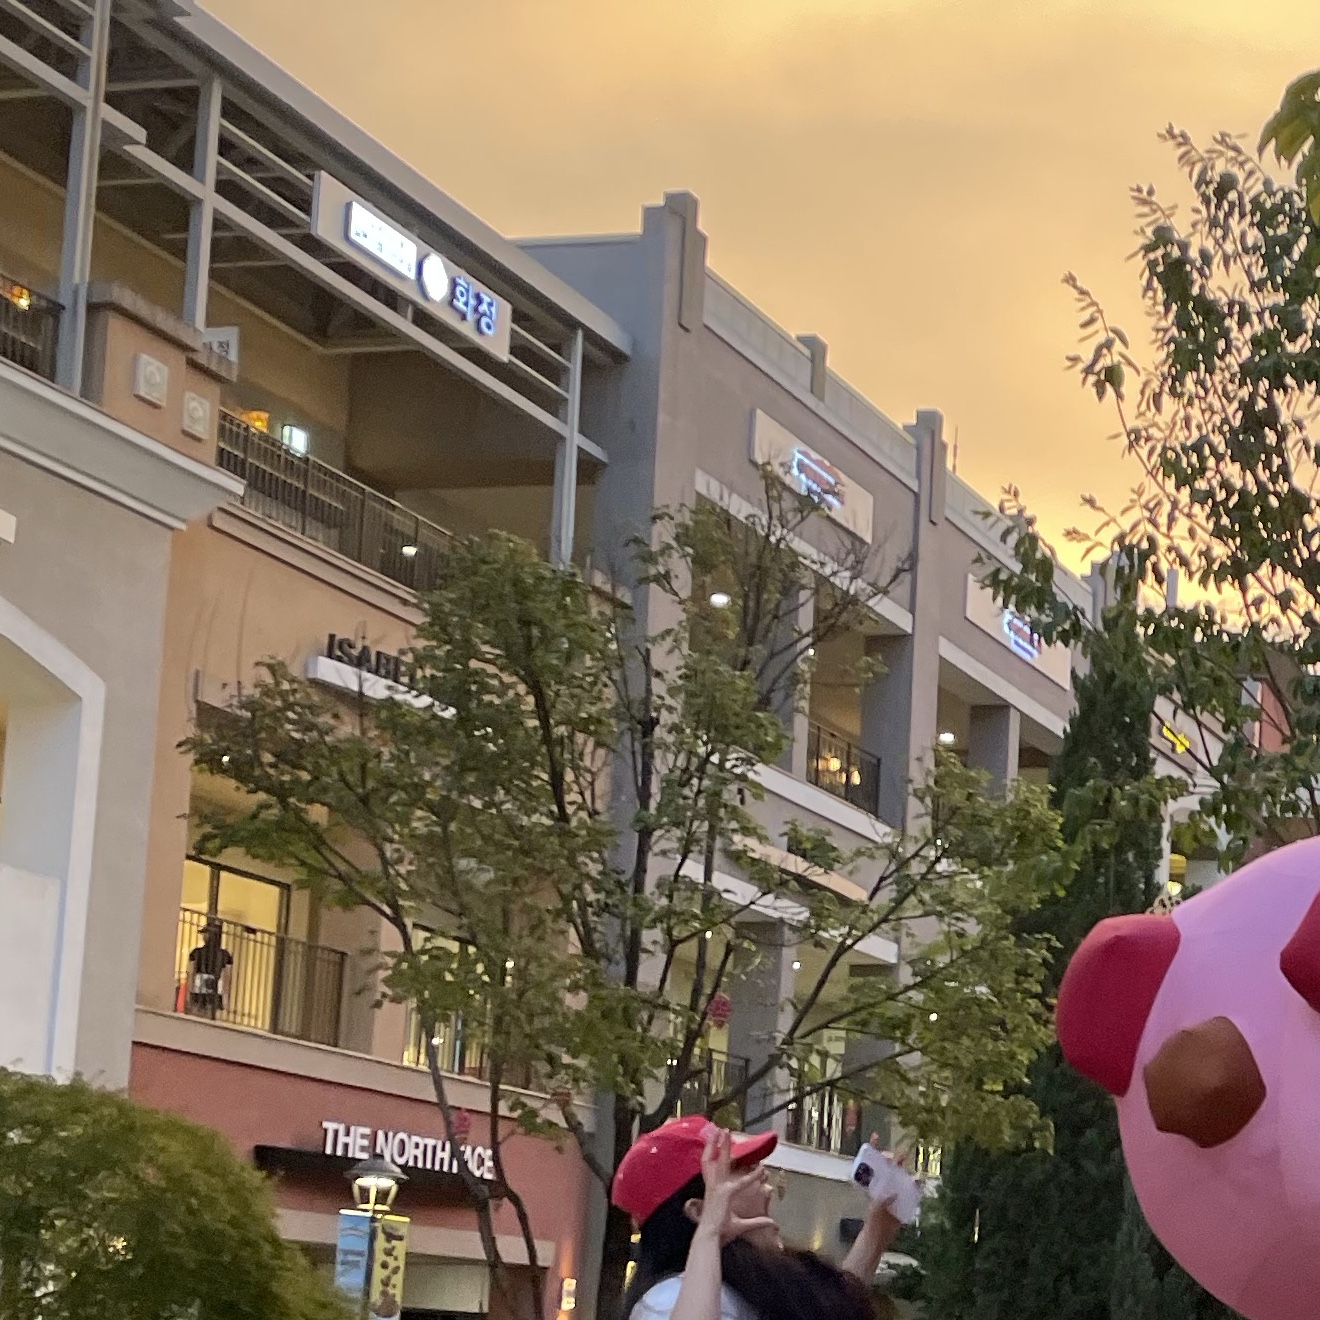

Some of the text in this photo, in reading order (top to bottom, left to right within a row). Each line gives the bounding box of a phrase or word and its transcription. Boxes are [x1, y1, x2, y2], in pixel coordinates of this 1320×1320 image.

[452, 275, 498, 337] 화정
[322, 1121, 372, 1160] THE
[375, 1129, 451, 1173] NORTH
